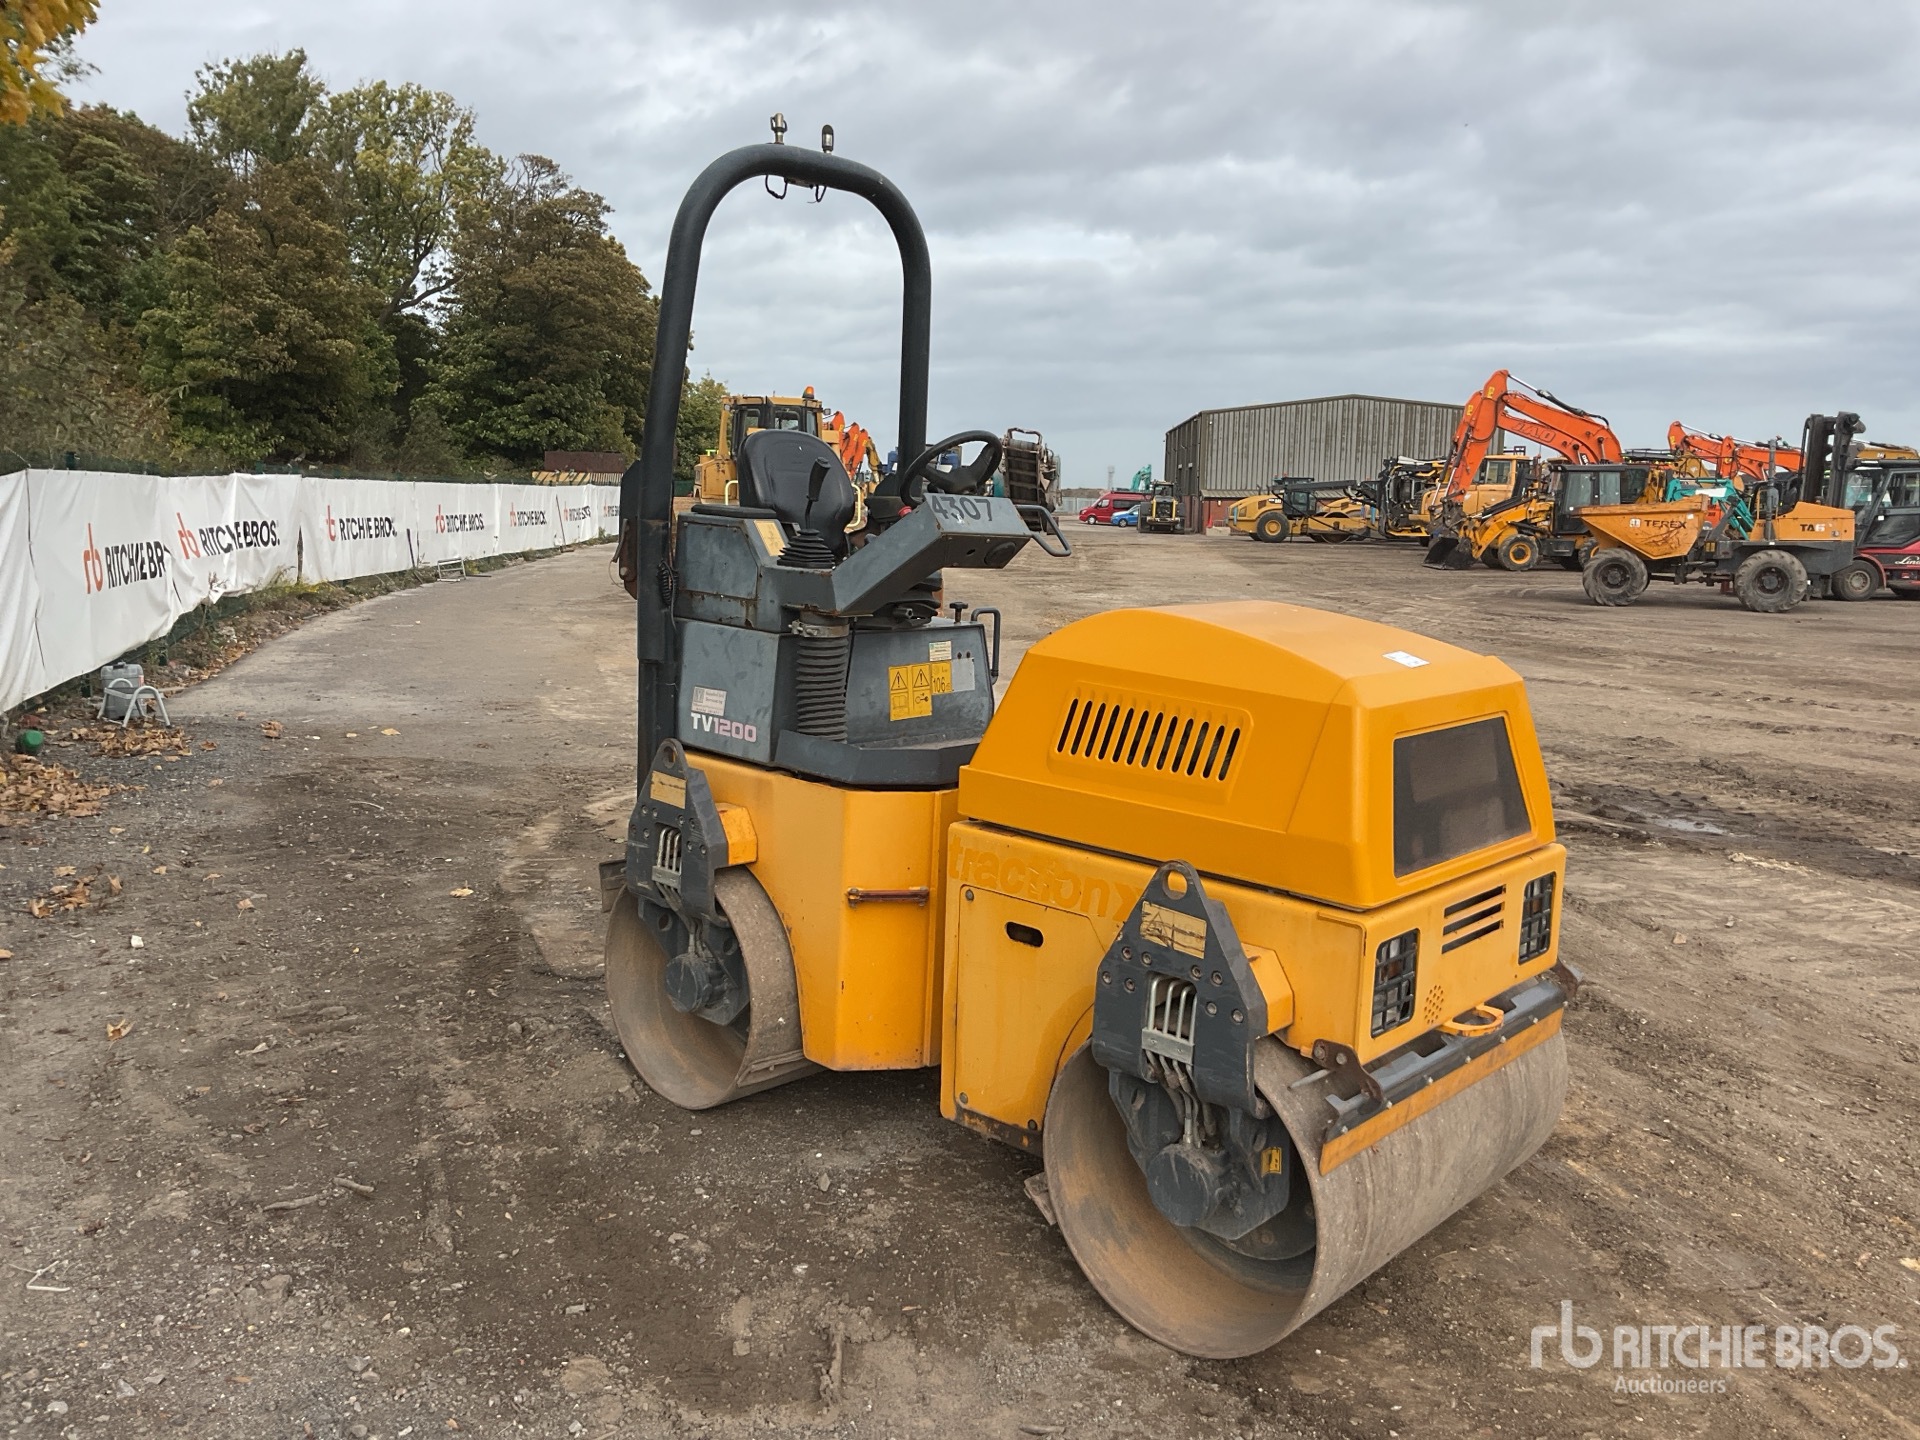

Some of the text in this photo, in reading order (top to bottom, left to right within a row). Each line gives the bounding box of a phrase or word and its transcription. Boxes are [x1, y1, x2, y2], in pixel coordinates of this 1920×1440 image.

[931, 494, 993, 521] 4307
[177, 512, 201, 560] rb
[339, 517, 373, 541] RTCHIE
[1644, 519, 1687, 530] TEREX
[1799, 523, 1826, 532] TA6
[83, 523, 171, 594] rb RITCHIE BR
[691, 712, 757, 743] TV1200
